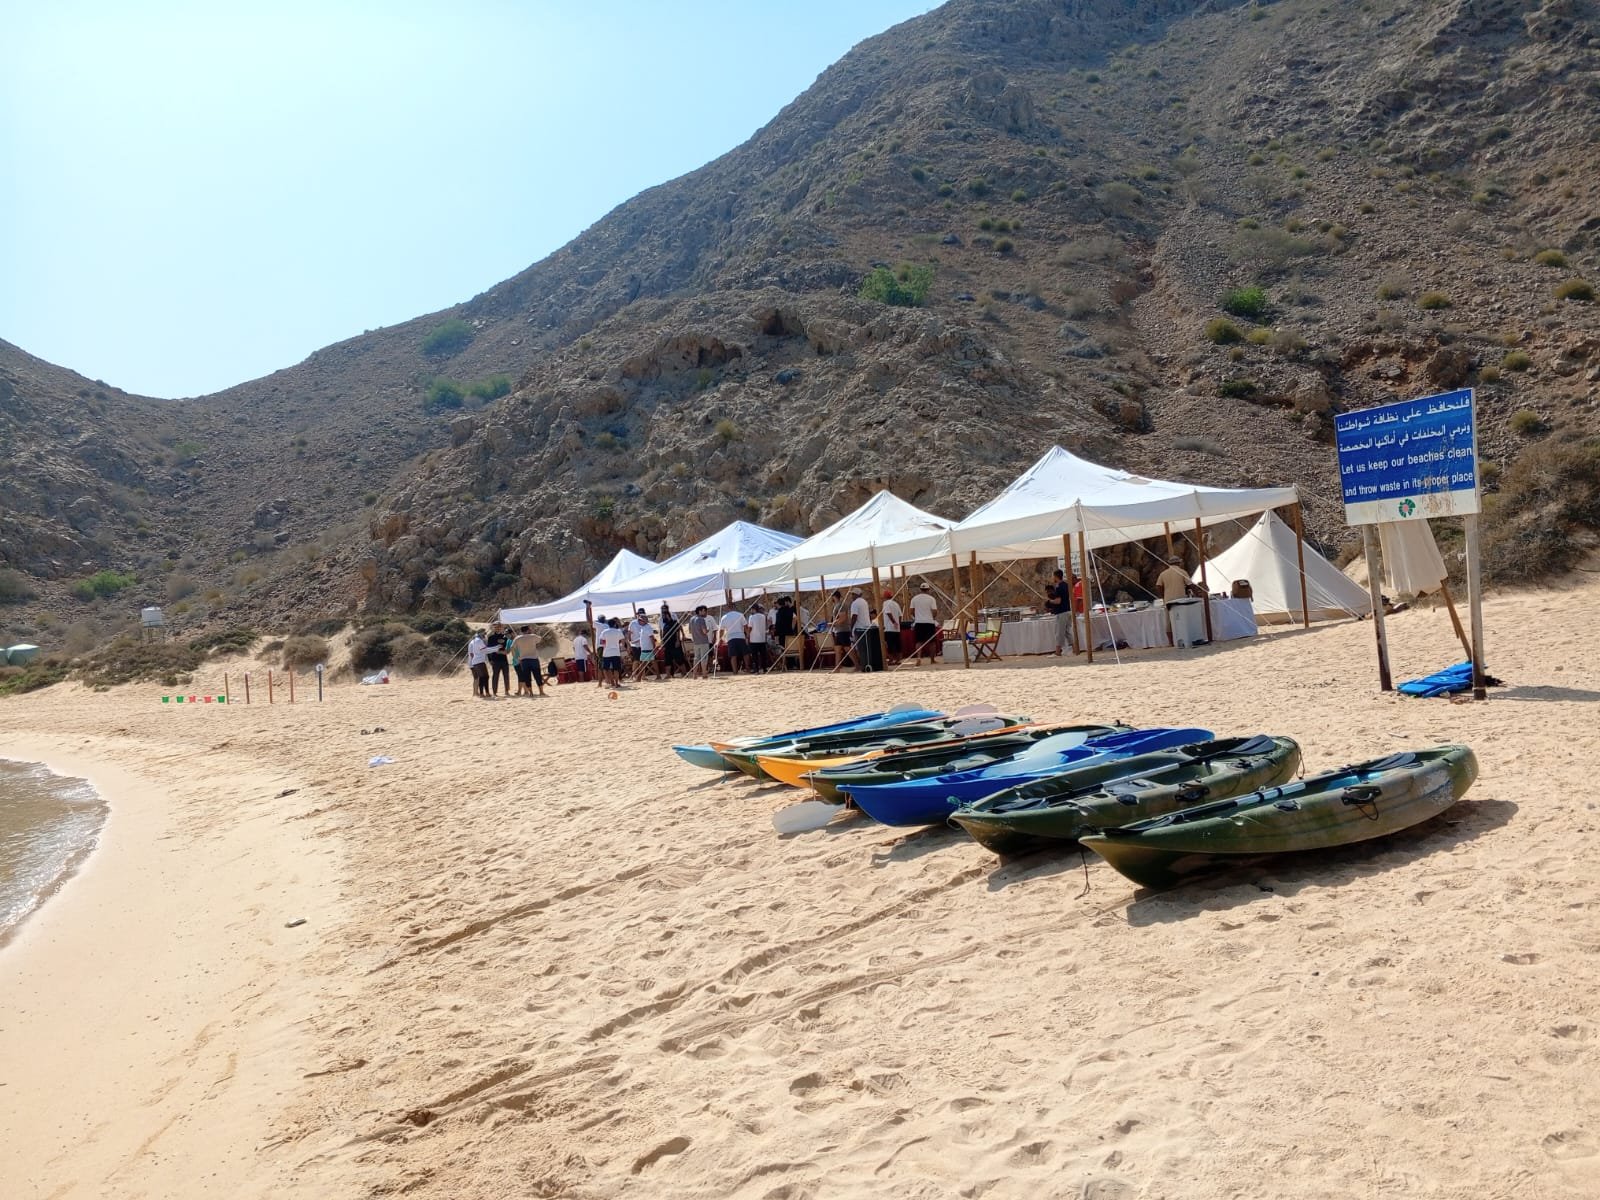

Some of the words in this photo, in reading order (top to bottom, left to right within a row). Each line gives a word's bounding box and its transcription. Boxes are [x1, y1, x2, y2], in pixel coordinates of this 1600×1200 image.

[1374, 412, 1398, 424] نظافة
[1402, 408, 1422, 422] على
[1338, 416, 1370, 432] شواطئنا
[1412, 424, 1445, 440] المخلفات
[1449, 422, 1470, 440] ونرمي
[1340, 438, 1372, 452] المخصصة
[1398, 430, 1409, 448] في
[1342, 464, 1354, 474] Let
[1356, 464, 1366, 472] us
[1368, 460, 1388, 470] keep
[1392, 458, 1404, 467] our
[1408, 451, 1445, 464] beaches
[1448, 448, 1472, 458] clean
[1345, 486, 1357, 496] and
[1359, 485, 1378, 494] throw
[1380, 480, 1400, 492] waste
[1402, 479, 1410, 489] in
[1412, 478, 1421, 488] its
[1424, 476, 1448, 488] proper
[1452, 472, 1473, 484] place
